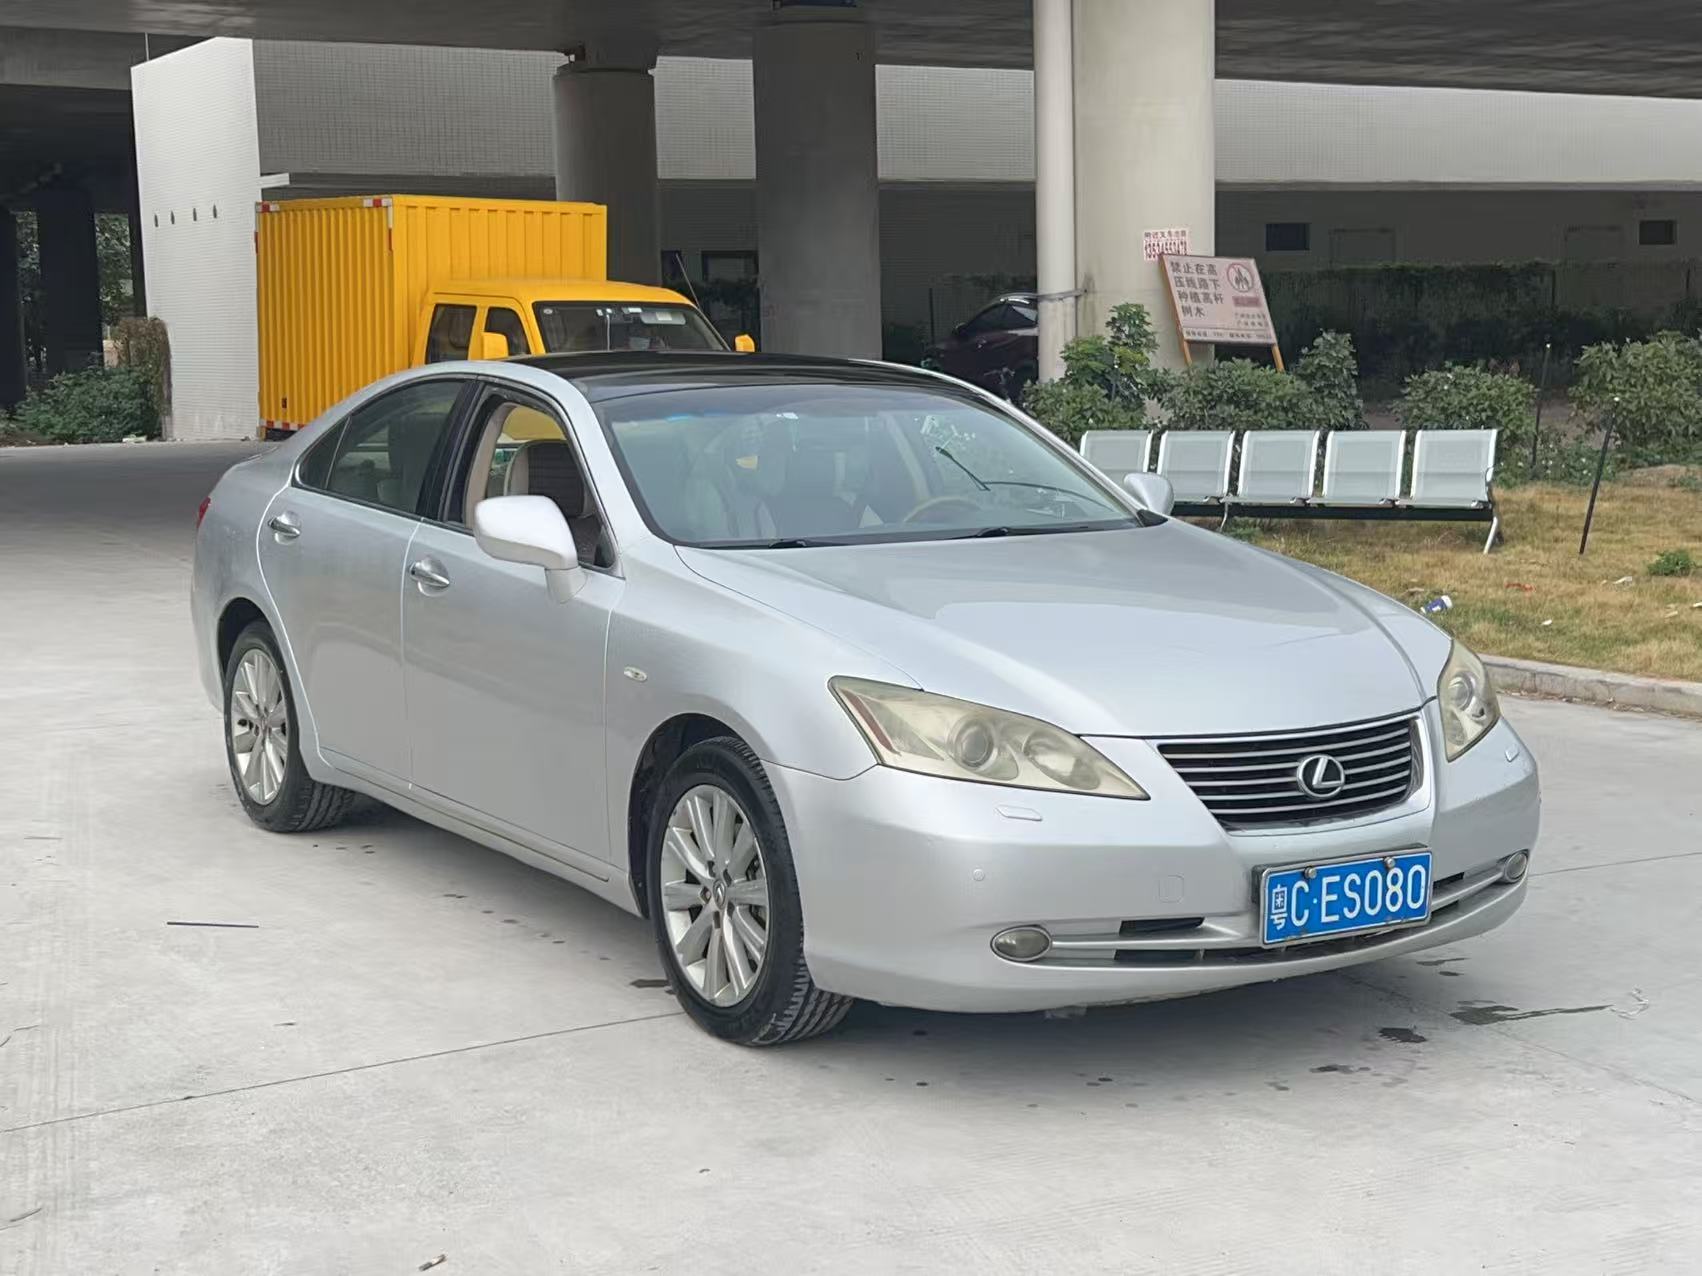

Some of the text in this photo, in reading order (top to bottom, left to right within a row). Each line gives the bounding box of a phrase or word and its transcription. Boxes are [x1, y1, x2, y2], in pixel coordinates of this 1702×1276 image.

[1170, 262, 1218, 276] 禁止在高
[1174, 276, 1222, 290] 压线路下
[1181, 305, 1205, 318] 树木
